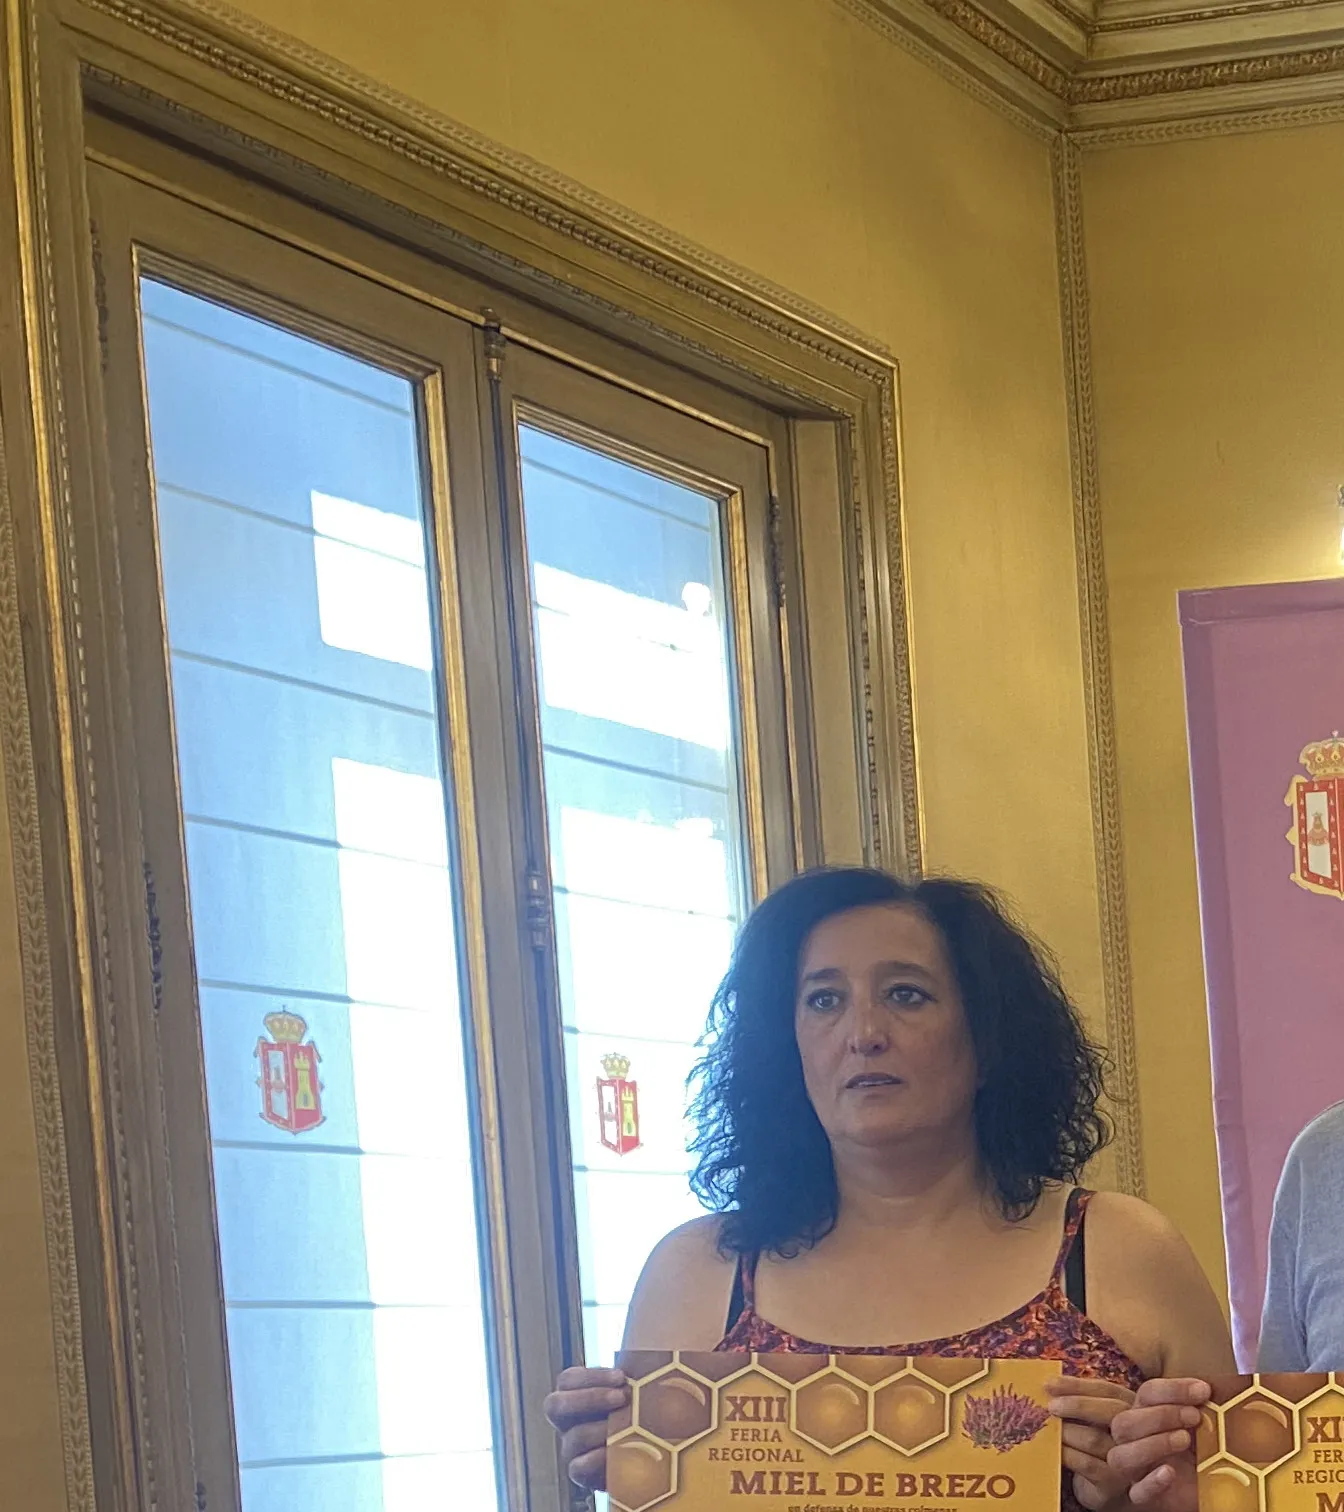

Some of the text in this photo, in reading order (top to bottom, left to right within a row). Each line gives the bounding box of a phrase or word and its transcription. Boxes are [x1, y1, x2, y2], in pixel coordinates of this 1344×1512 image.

[725, 1396, 787, 1423] XIII
[730, 1428, 783, 1443] FERIA
[708, 1447, 804, 1463] REGIONAL
[730, 1470, 1016, 1499] MIEL DE BREZO
